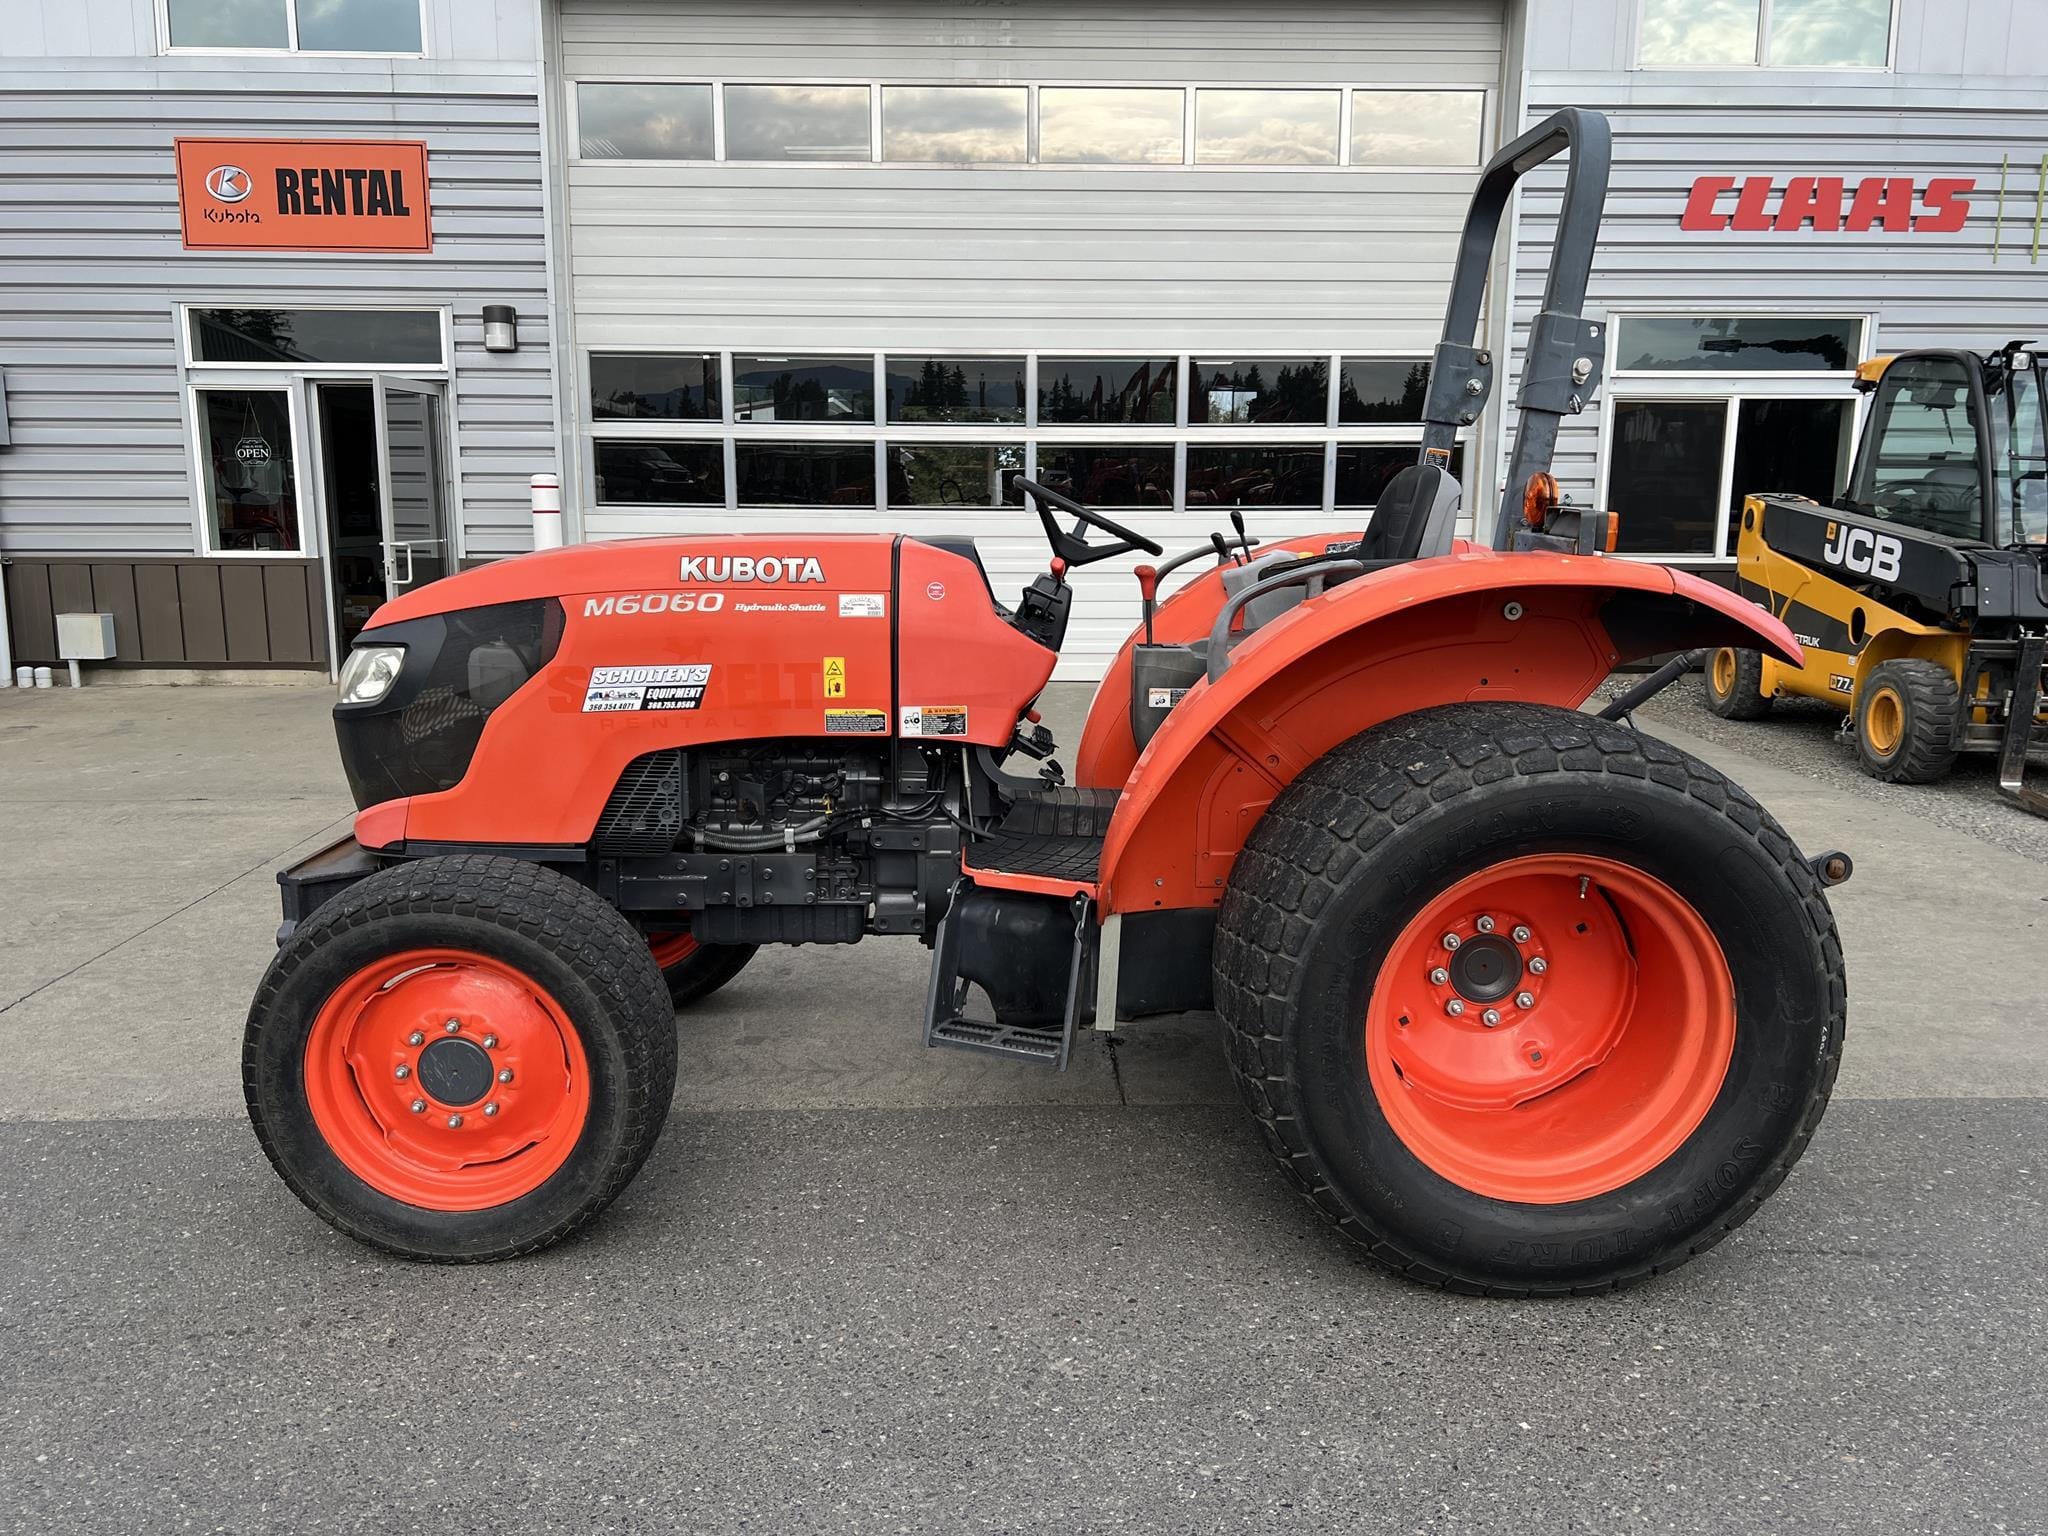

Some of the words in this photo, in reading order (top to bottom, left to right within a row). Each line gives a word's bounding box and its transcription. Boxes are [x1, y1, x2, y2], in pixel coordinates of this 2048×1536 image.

[275, 167, 410, 217] RENTAL
[1680, 176, 1977, 233] CLAAS
[203, 208, 261, 224] Kubota
[237, 448, 269, 458] OPEN
[1824, 525, 1902, 582] JCB
[679, 555, 826, 583] KUBOTA
[583, 593, 725, 617] M6060
[735, 603, 788, 613] Hydraulic
[787, 603, 827, 612] Shuttle
[593, 667, 707, 685] SCHOLTEN'S
[645, 686, 704, 700] EQUIPMENT
